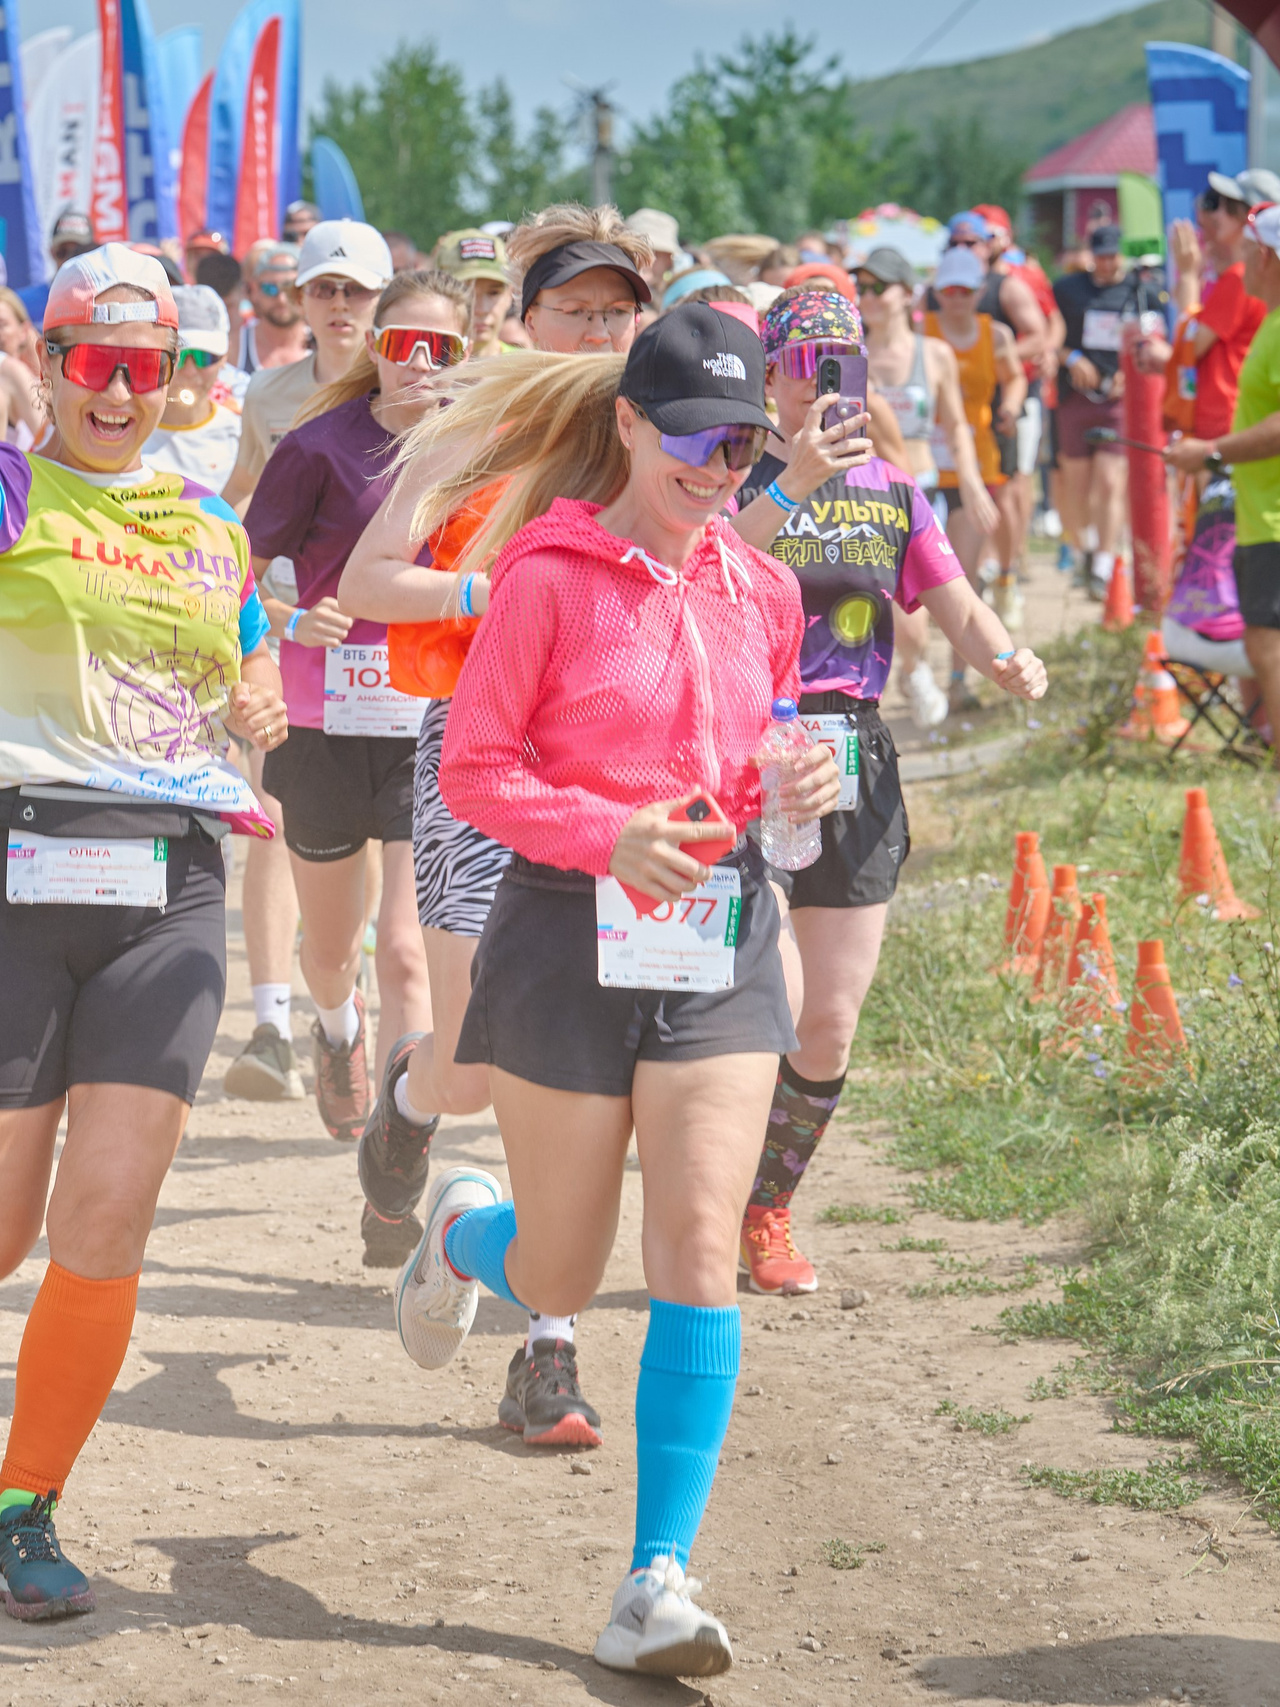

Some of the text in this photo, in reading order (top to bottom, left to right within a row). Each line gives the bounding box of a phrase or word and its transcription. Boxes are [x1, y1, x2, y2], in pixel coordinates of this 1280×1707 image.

[702, 358, 734, 370] NORTH
[777, 511, 819, 536] КА
[811, 500, 909, 532] УЛЬТРА
[72, 537, 240, 584] LUKA ULTR
[769, 535, 897, 570] ЕЙЛ БАЙК
[78, 564, 181, 616] TRAIL
[343, 649, 366, 661] ВТБ
[342, 667, 391, 688] 10
[356, 694, 418, 703] АНАСТАСИЯ
[69, 847, 112, 858] ОЛЬГА
